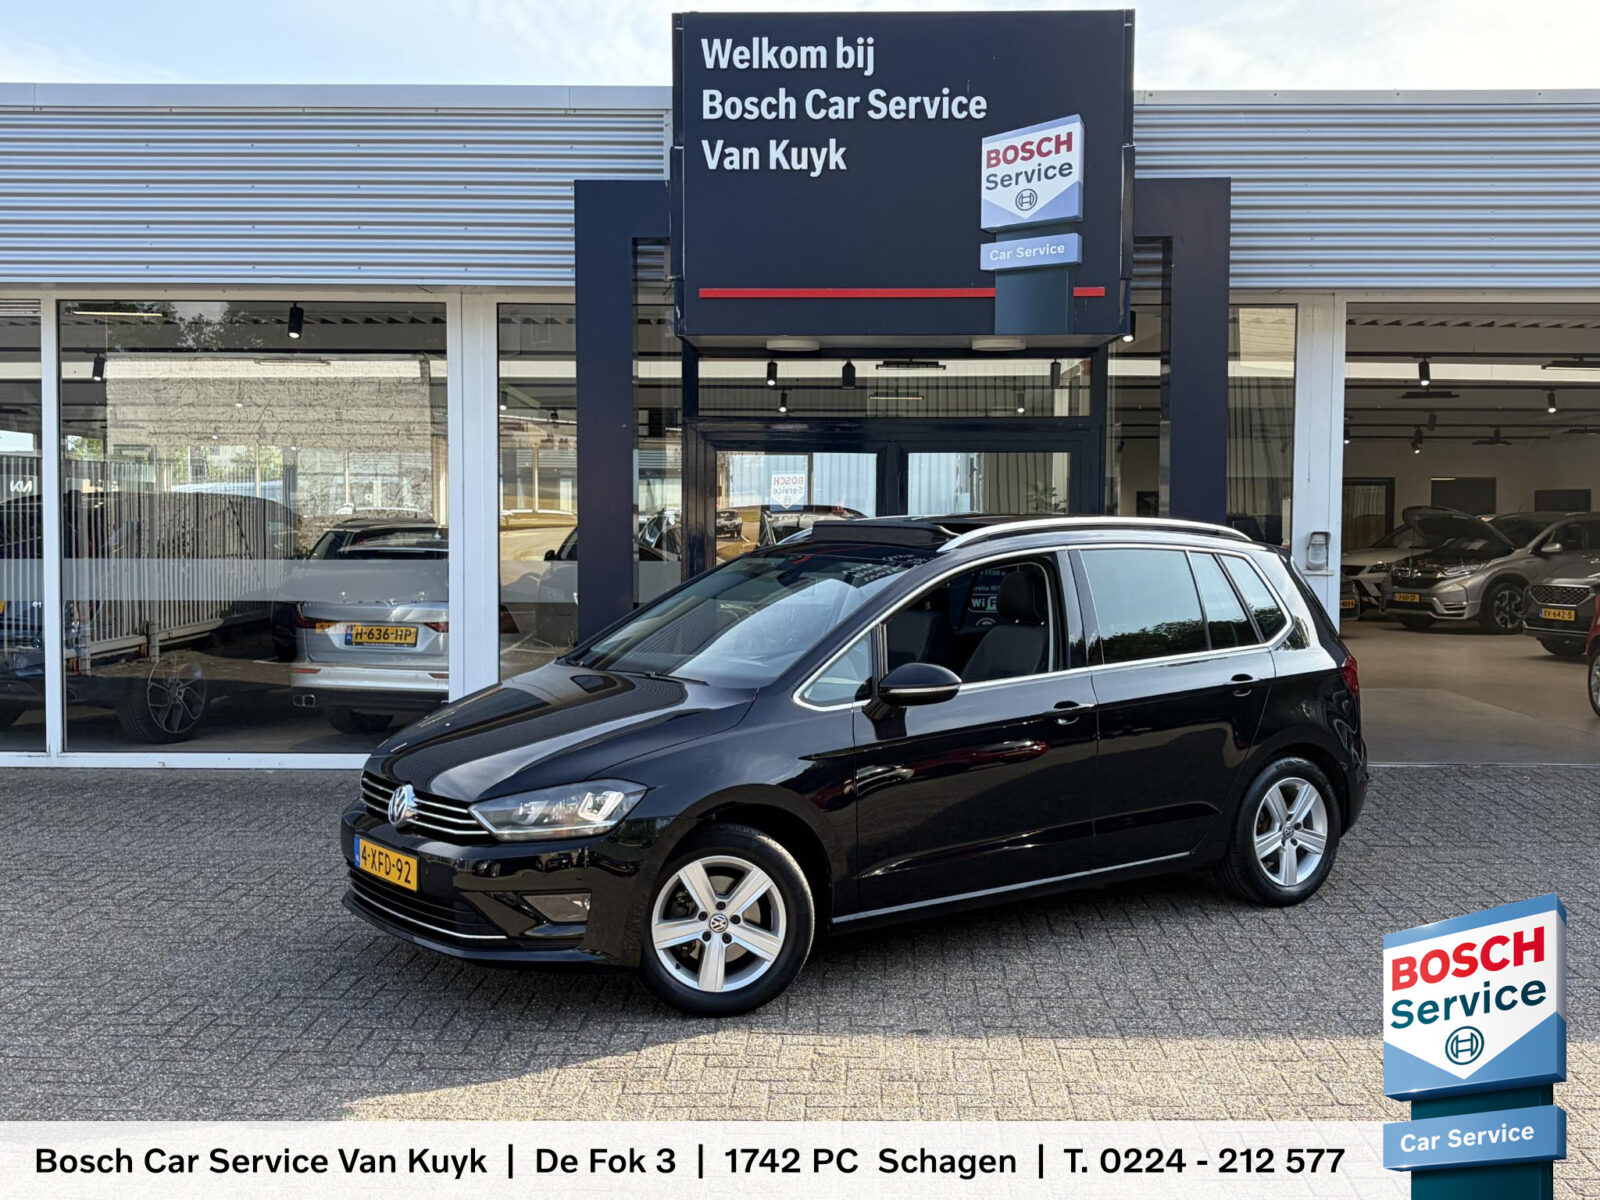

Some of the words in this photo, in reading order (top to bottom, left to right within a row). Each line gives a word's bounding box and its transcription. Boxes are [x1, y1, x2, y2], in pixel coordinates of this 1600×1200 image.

[701, 37, 828, 70] Welkom
[837, 37, 875, 76] bij
[702, 88, 797, 120] Bosch
[805, 89, 861, 120] Car
[868, 88, 987, 120] Service
[702, 140, 760, 171] Van
[770, 138, 847, 177] Kuyk
[986, 131, 1073, 169] BOSCH
[985, 161, 1073, 191] Service
[989, 249, 1013, 262] Car
[1016, 242, 1065, 259] Service
[355, 628, 412, 641] H-636-HP
[361, 845, 412, 884] 4-XFD-92
